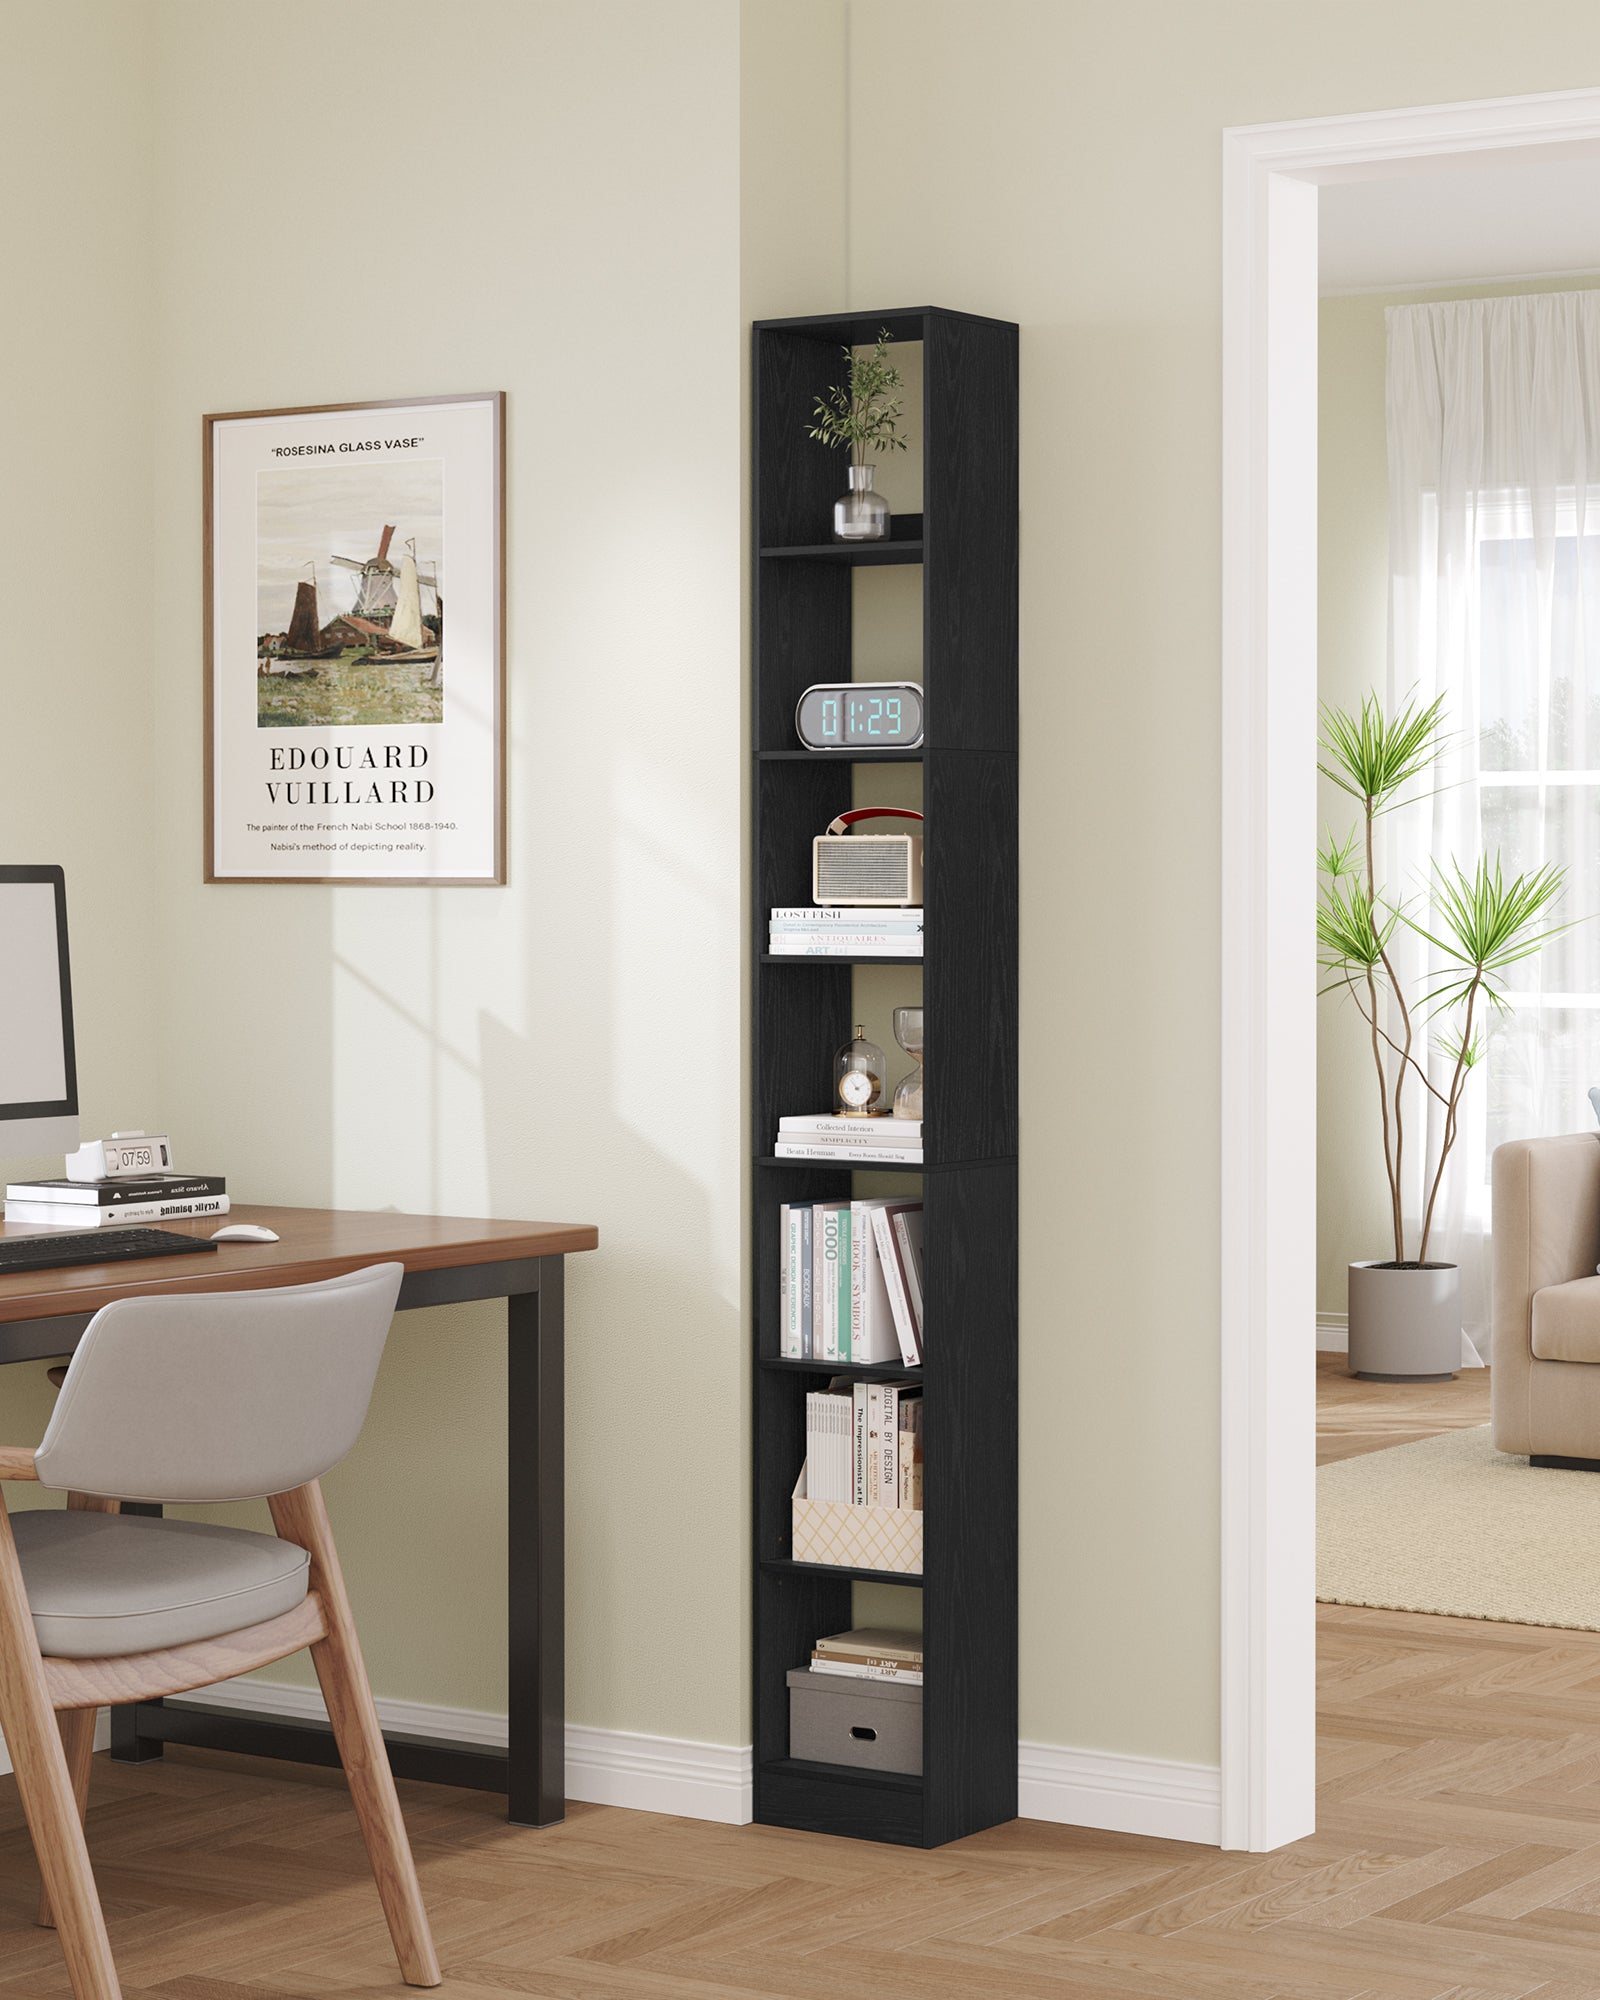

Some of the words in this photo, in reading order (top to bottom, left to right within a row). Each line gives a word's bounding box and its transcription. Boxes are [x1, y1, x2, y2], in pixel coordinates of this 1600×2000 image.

[339, 440, 382, 453] GLASS
[821, 697, 902, 736] 01:29
[269, 745, 428, 770] EDOUARD
[265, 780, 434, 805] VUILLARD
[246, 823, 260, 831] The
[262, 823, 288, 832] painter
[290, 823, 299, 831] of
[300, 823, 314, 831] the
[317, 823, 348, 831] French
[375, 822, 407, 831] School
[409, 822, 458, 831] 1868-1940.
[302, 842, 336, 851] method
[339, 842, 348, 850] of
[350, 842, 393, 852] depicting
[396, 842, 426, 852] reality.
[776, 910, 810, 919] LOST
[812, 910, 841, 919] FISH
[806, 946, 830, 955] ART
[816, 1123, 846, 1132] Collected
[847, 1124, 874, 1133] Interiors
[122, 1152, 135, 1166] 07
[137, 1150, 151, 1165] 59
[825, 1217, 838, 1261] 1000
[852, 1240, 860, 1272] BOOK
[852, 1284, 860, 1341] SYMBOLS
[884, 1388, 892, 1426] DIGITAL
[884, 1431, 893, 1443] BY
[856, 1425, 864, 1484] Impressionists
[884, 1449, 893, 1484] DESIGN
[857, 1486, 863, 1494] at
[880, 1660, 898, 1668] ART
[880, 1668, 898, 1676] ART
